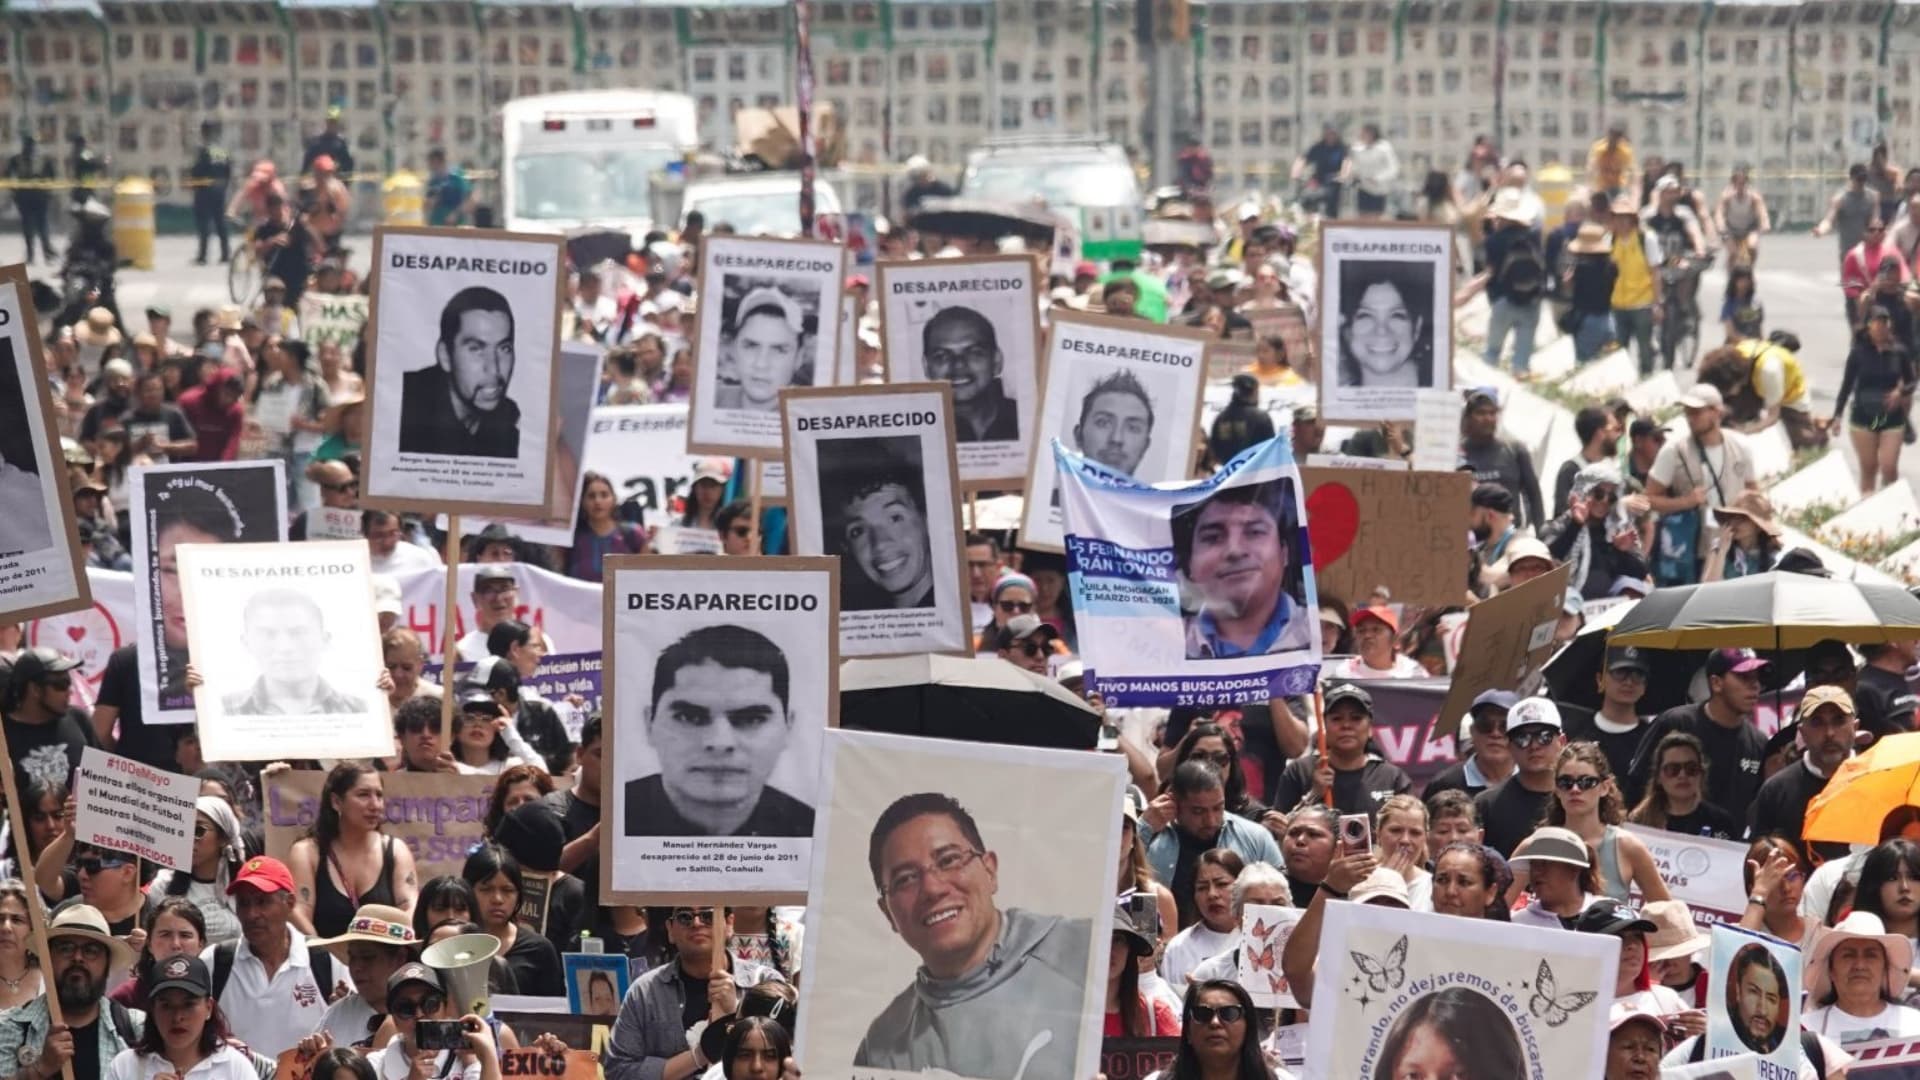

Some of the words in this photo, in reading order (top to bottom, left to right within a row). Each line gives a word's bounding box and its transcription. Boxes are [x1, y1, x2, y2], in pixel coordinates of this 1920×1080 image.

[1332, 241, 1443, 256] DESAPARECIDA
[391, 253, 548, 276] DESAPARECIDO
[713, 253, 834, 273] DESAPARECIDO
[893, 277, 1023, 295] DESAPARECIDO
[1061, 338, 1194, 368] DESAPARECIDO
[797, 410, 937, 432] DESAPARECIDO
[1089, 541, 1174, 565] FERNANDO
[12, 572, 23, 580] de
[200, 562, 355, 579] DESAPARECIDO
[1115, 560, 1169, 578] TOVAR
[627, 591, 818, 613] DESAPARECIDO
[1095, 593, 1130, 602] MARZO
[555, 680, 567, 693] la
[569, 678, 594, 692] vida
[1098, 682, 1127, 692] TIVO
[1130, 681, 1179, 692] MANOS
[1181, 676, 1268, 692] BUSCADORAS
[1177, 695, 1194, 706] 33
[1197, 694, 1214, 705] 48
[1218, 692, 1231, 704] 21
[1234, 691, 1248, 703] 21
[1251, 689, 1269, 700] 70
[107, 757, 170, 786] #10DeMayo
[81, 768, 123, 788] Mientras
[125, 782, 146, 795] ellos
[147, 790, 195, 809] organizan
[88, 788, 97, 797] el
[99, 789, 139, 806] Mundial
[140, 802, 150, 812] de
[87, 803, 131, 820] nosotras
[132, 812, 175, 835] buscamos
[177, 829, 185, 837] a
[115, 825, 156, 844] nuestros
[93, 834, 176, 867] DESAPARECIDOS.
[662, 841, 695, 849] Manuel
[697, 840, 745, 849] Hernández
[747, 841, 777, 851] Vargas
[640, 853, 700, 861] desaparecido
[740, 854, 762, 862] junio
[689, 865, 723, 874] Saltillo,
[725, 865, 764, 873] Coahuila
[1409, 972, 1500, 996] dejaremos
[1390, 993, 1408, 1014] no
[1500, 993, 1519, 1013] de
[1757, 1059, 1798, 1080] RENZO
